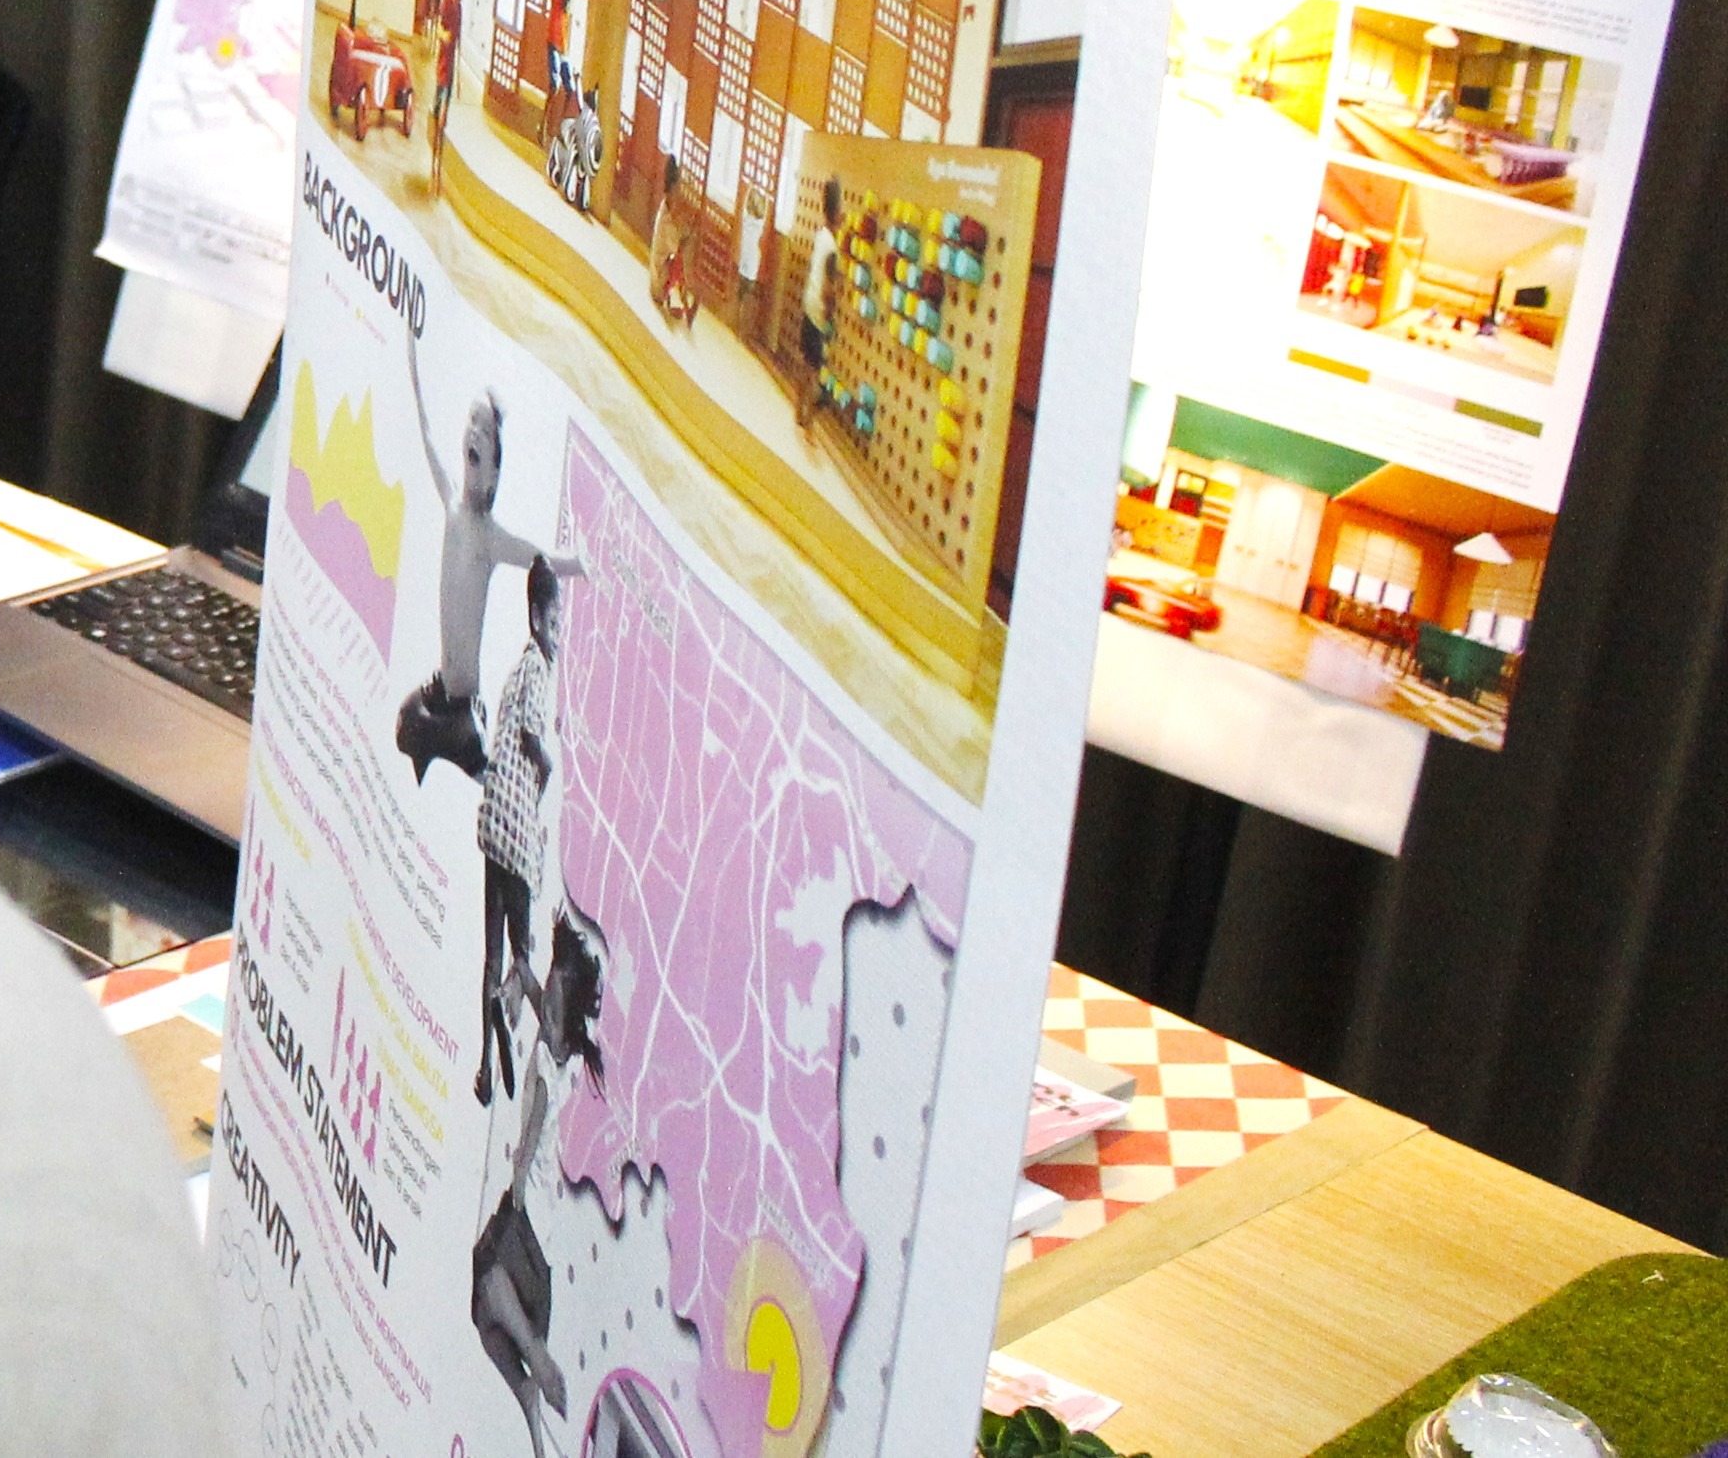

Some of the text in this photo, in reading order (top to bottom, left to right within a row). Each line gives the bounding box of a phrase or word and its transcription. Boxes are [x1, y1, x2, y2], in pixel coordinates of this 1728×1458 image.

[303, 149, 426, 340] BACKGROUND
[236, 920, 304, 1094] PROBLEM
[304, 1064, 398, 1290] STATEMENT
[391, 961, 460, 1064] DEVELOPMENT
[221, 1088, 301, 1290] CREATIVITY
